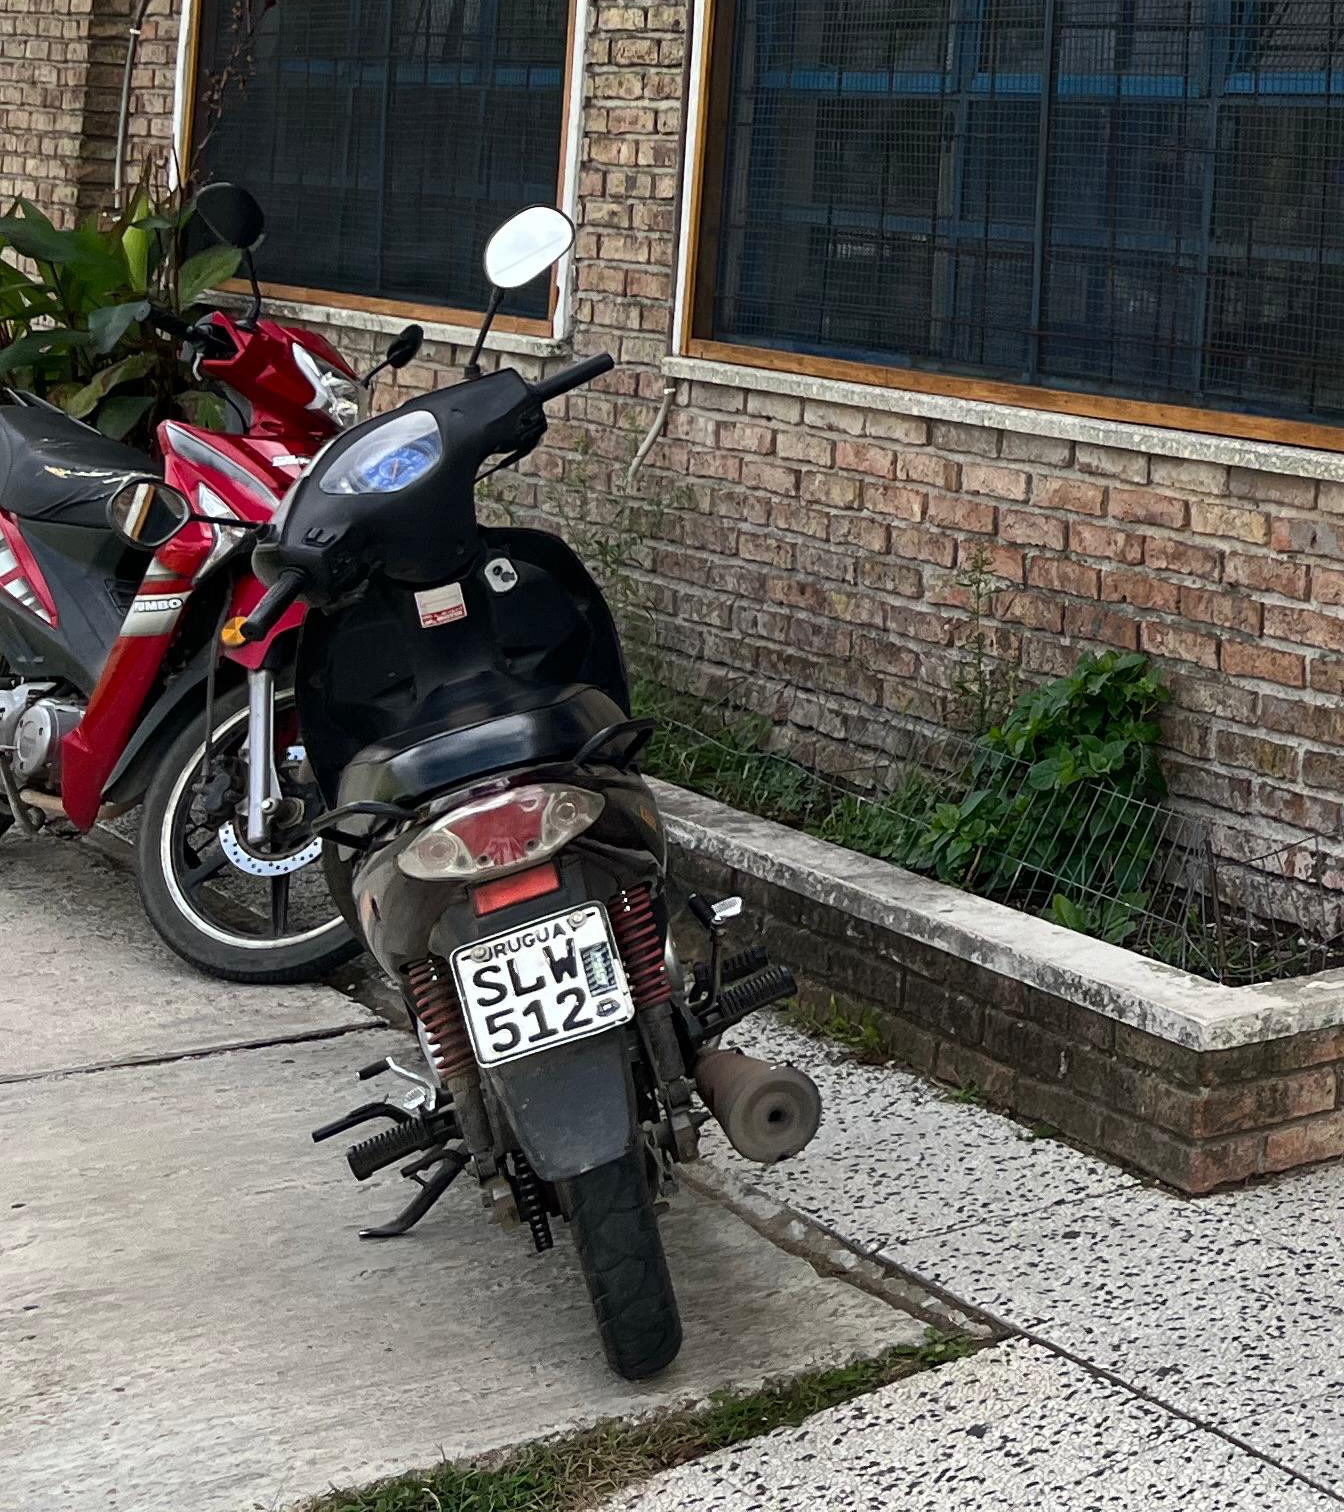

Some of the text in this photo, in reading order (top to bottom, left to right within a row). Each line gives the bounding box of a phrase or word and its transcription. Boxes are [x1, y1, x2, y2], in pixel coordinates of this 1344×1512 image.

[472, 937, 579, 1007] SLW
[481, 919, 577, 963] RUGUA
[484, 987, 594, 1053] 512
